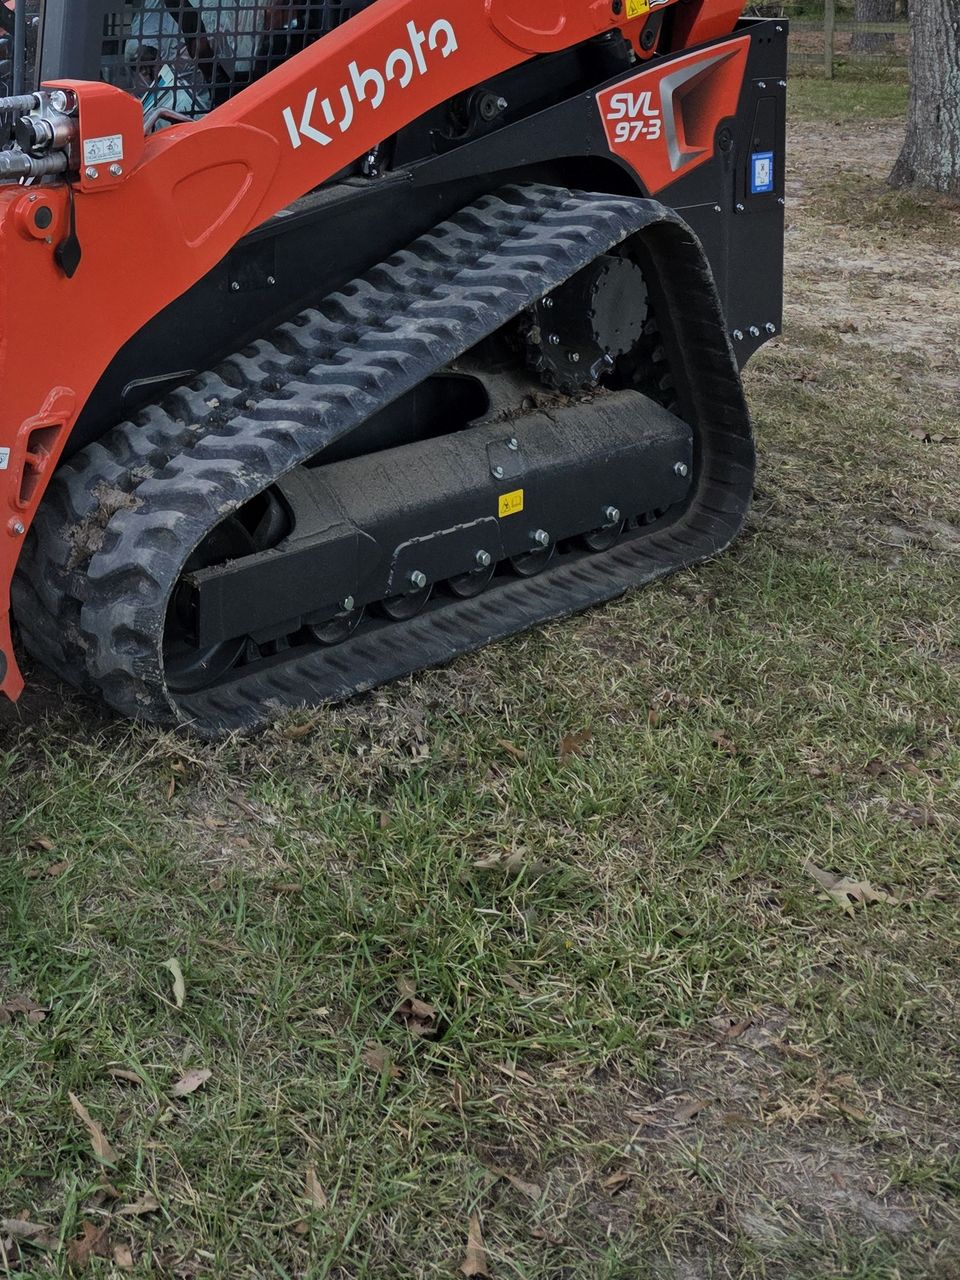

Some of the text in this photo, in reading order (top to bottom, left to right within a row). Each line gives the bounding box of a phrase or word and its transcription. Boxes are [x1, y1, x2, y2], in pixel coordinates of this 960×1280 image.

[282, 18, 459, 150] Kubota
[606, 91, 660, 120] SVL
[614, 119, 662, 143] 97-3
